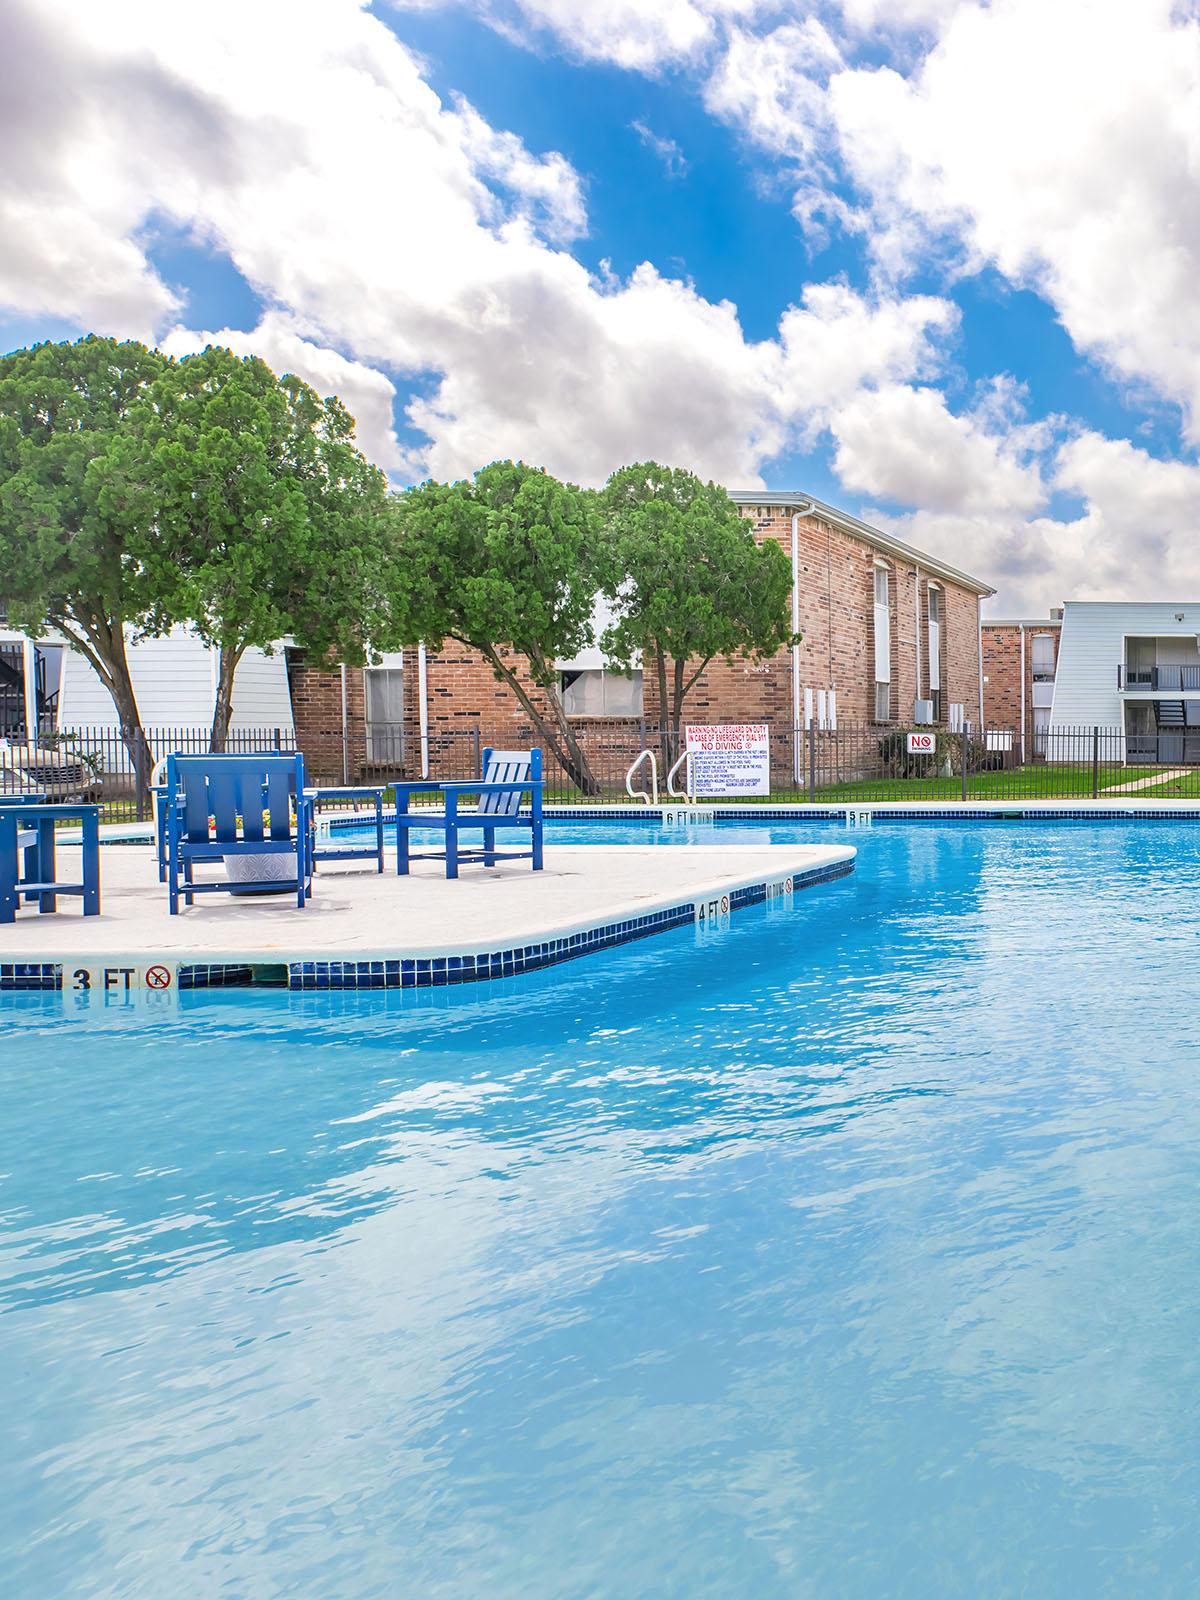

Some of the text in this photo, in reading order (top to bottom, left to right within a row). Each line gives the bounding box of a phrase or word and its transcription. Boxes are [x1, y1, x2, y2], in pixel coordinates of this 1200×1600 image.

[719, 726, 744, 734] LIFEGUARD
[746, 726, 752, 734] ON
[753, 726, 766, 734] DUTY
[716, 742, 742, 750] DIVING
[678, 812, 687, 822] FT
[850, 811, 870, 822] 5 FT
[699, 900, 718, 920] 4 FT
[73, 968, 135, 990] 3 FT
